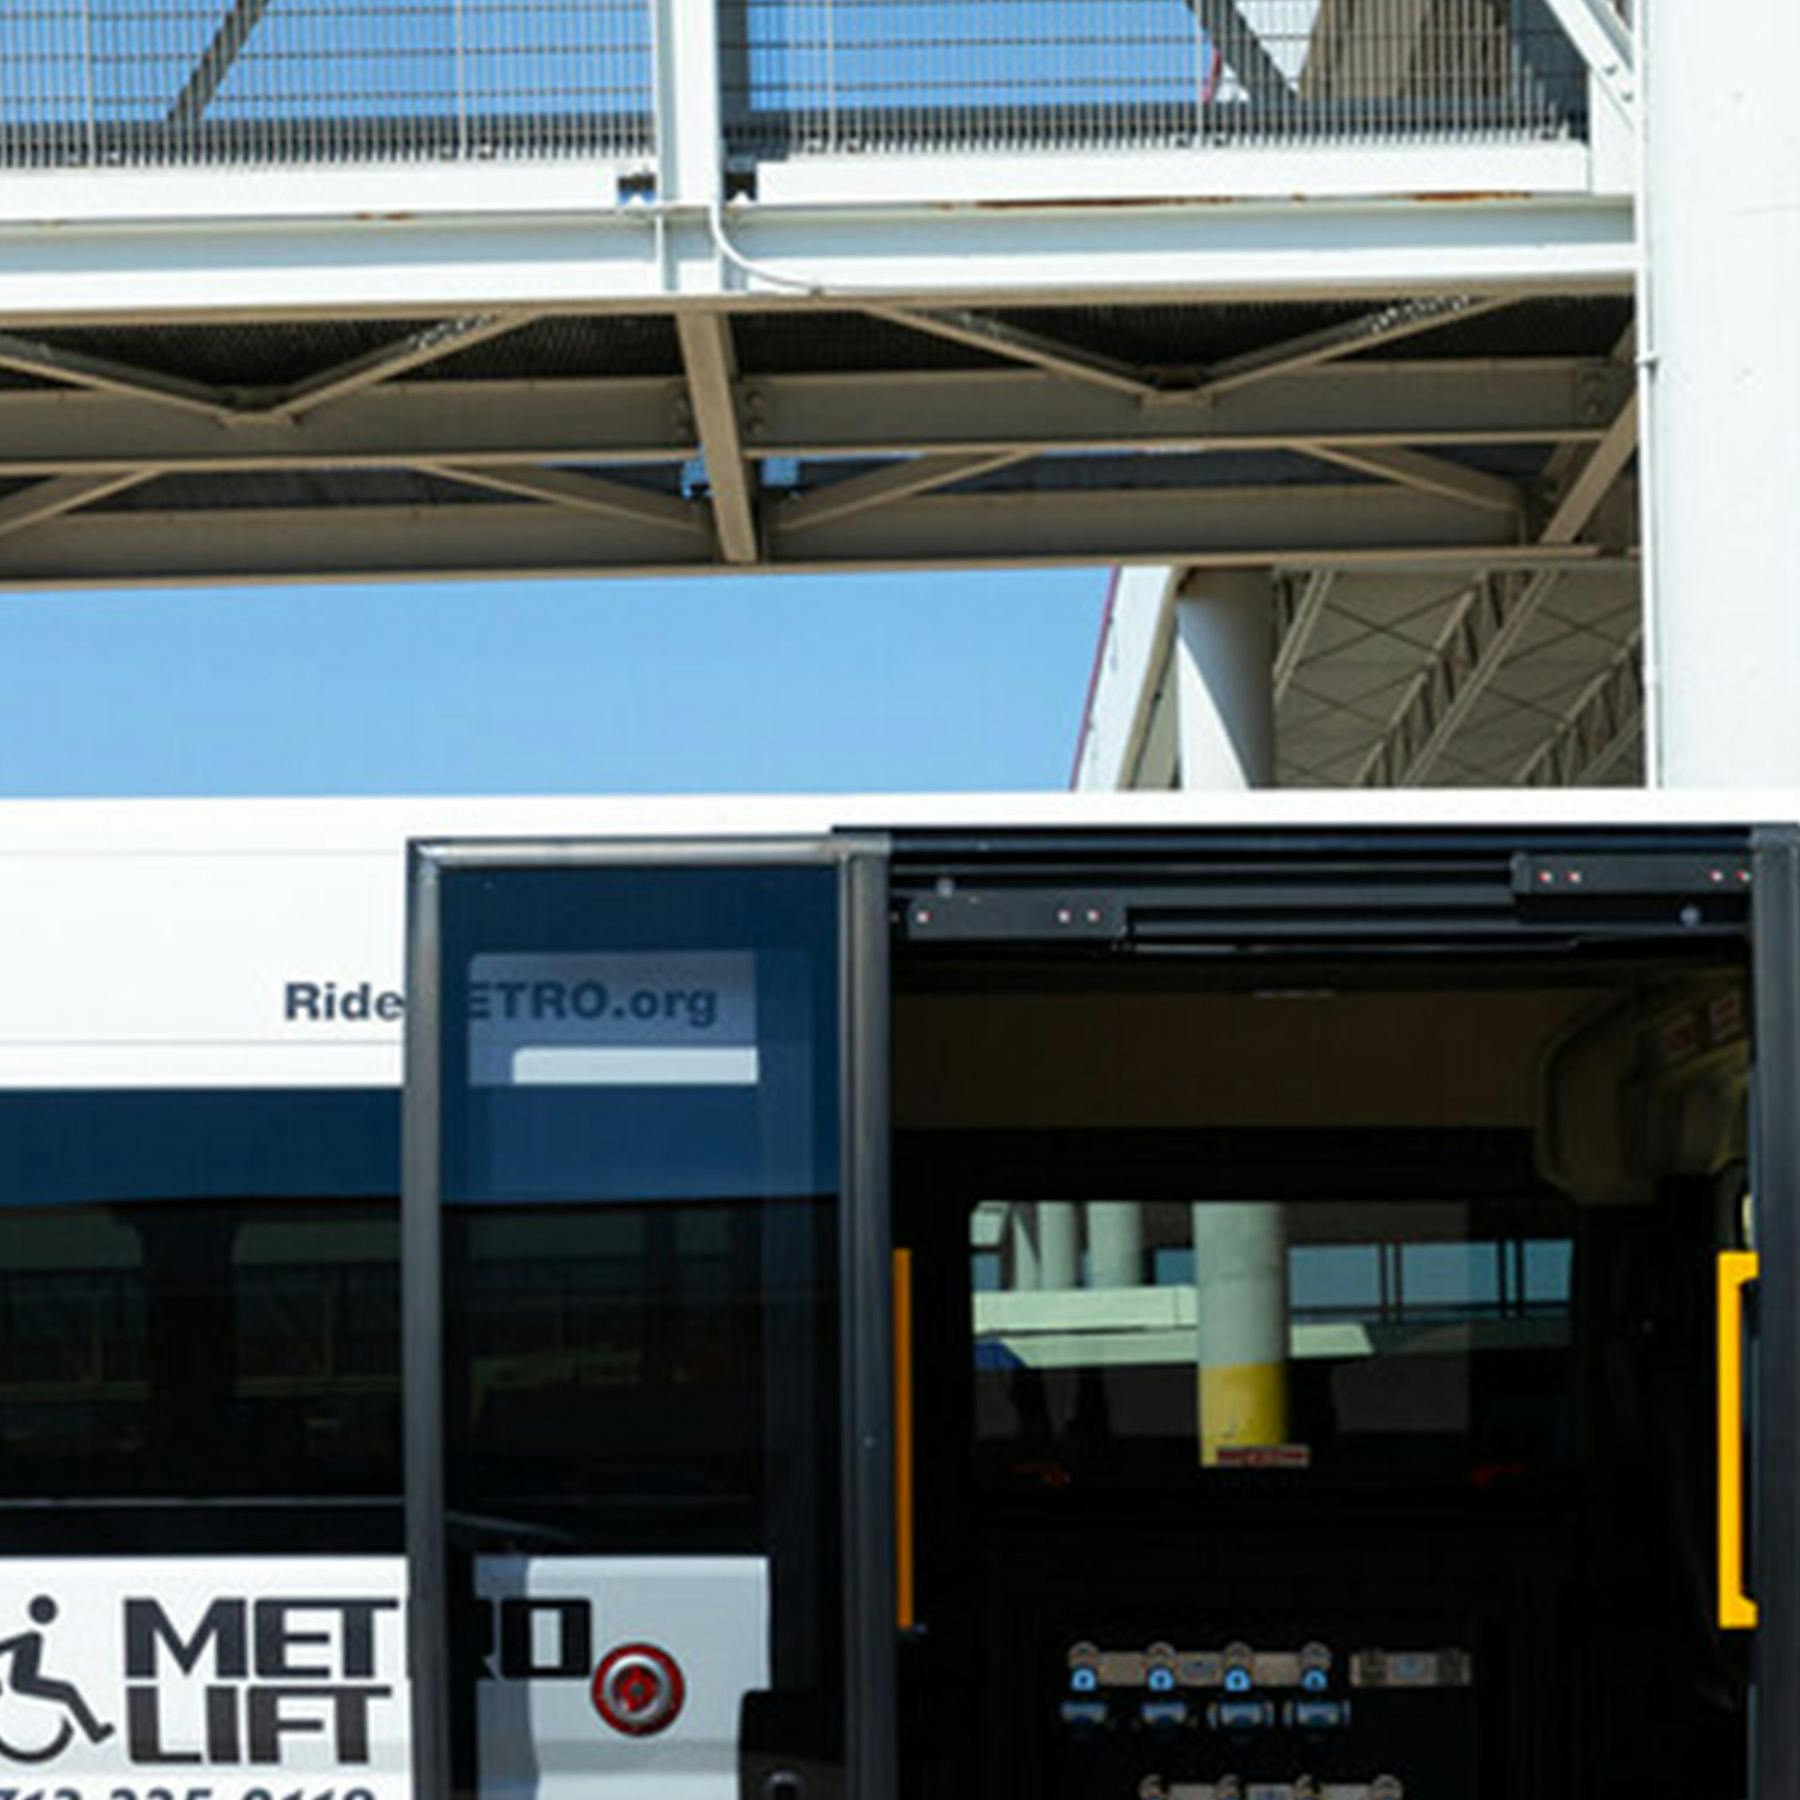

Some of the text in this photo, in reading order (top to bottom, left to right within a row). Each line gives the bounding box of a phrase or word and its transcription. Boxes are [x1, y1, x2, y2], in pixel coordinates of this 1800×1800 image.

[284, 981, 718, 1028] RideETRO.org
[123, 1597, 592, 1679] METO
[124, 1685, 393, 1765] LIFT
